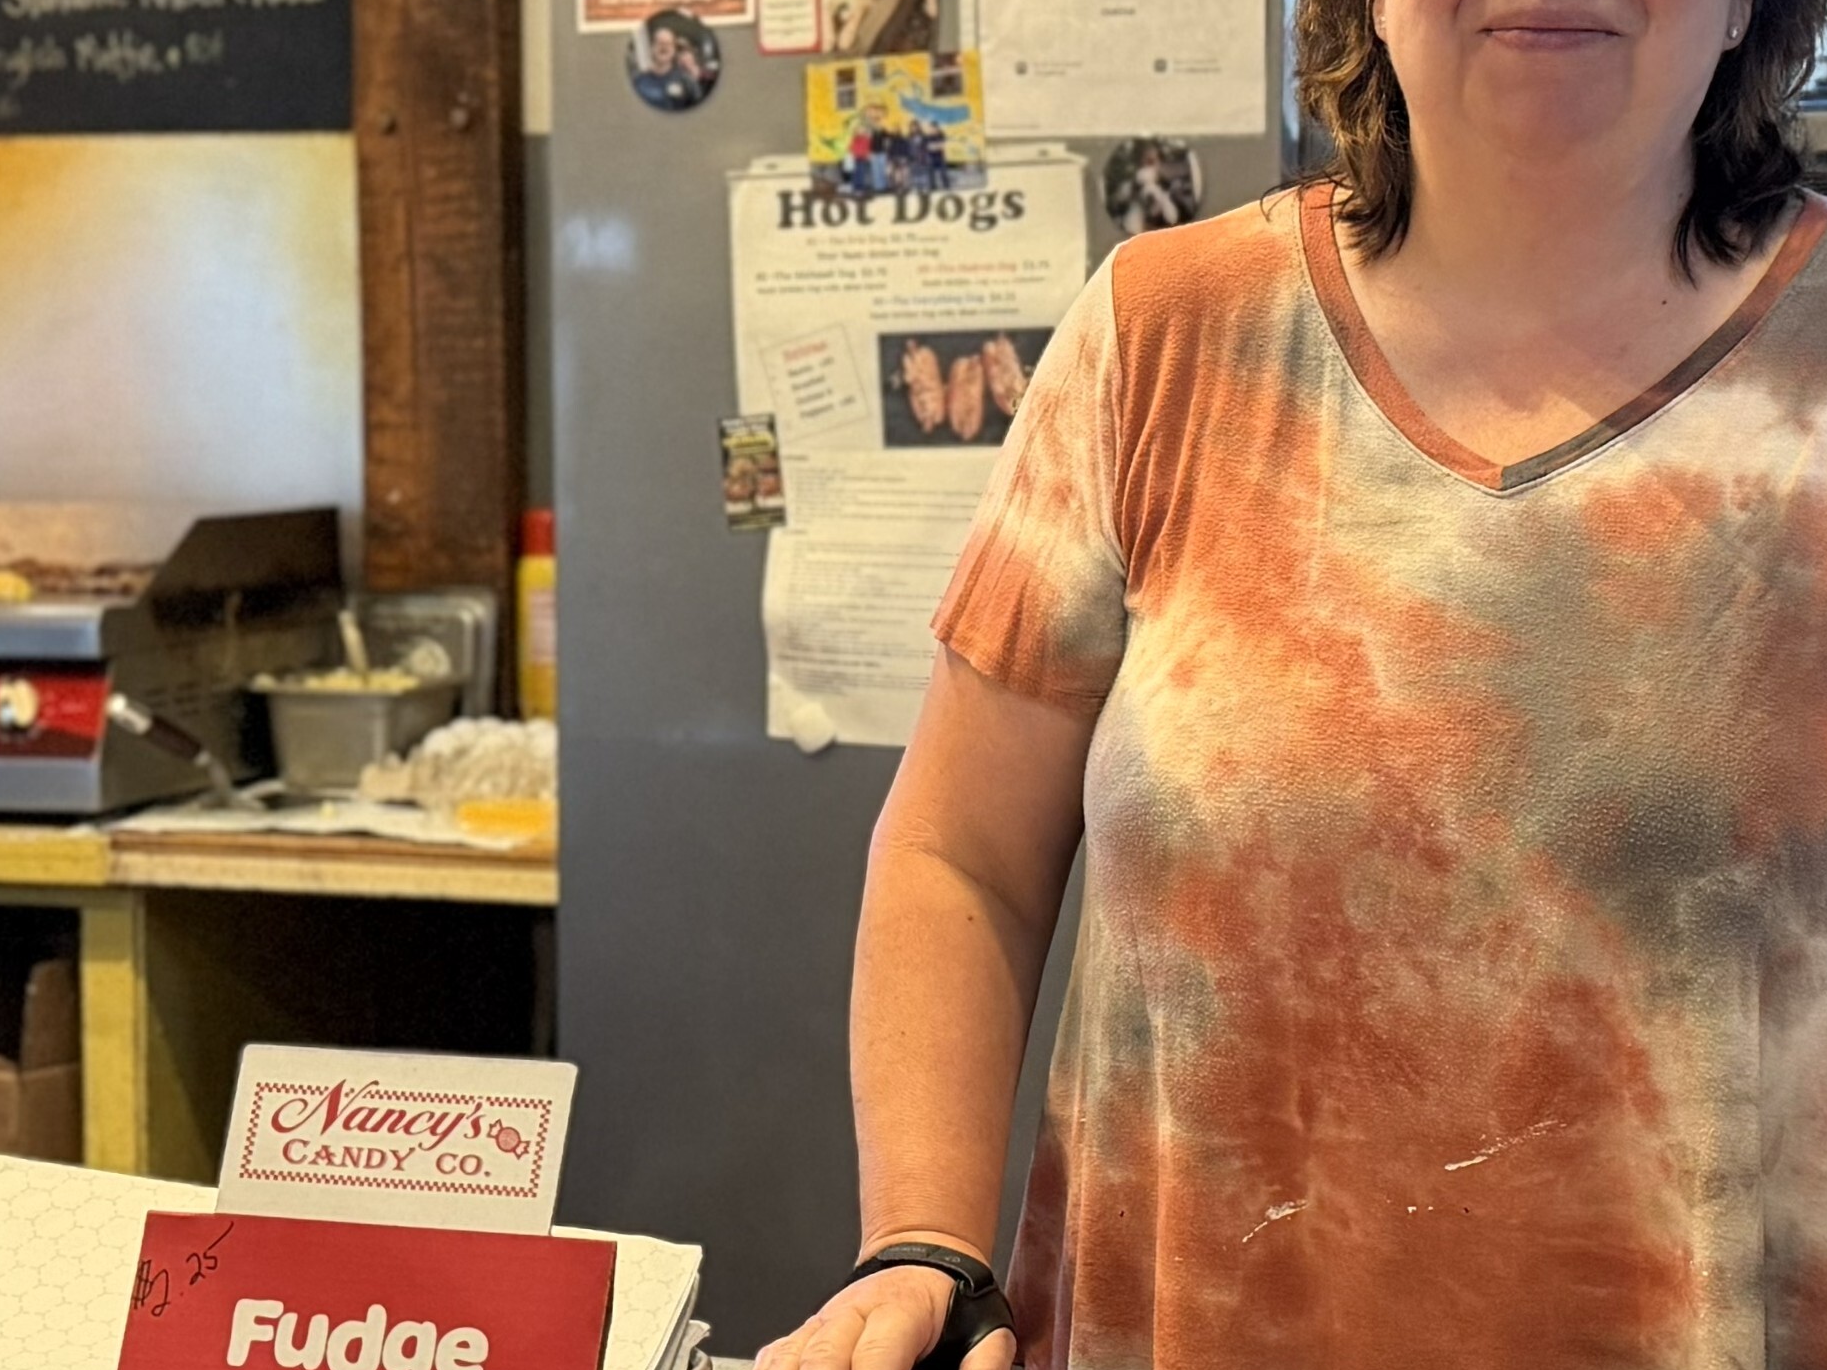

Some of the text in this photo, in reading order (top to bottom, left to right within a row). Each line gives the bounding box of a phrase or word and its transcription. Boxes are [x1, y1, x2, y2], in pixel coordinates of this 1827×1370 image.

[776, 188, 1026, 233] Hot Dogs
[271, 1078, 487, 1151] Nancy's
[282, 1138, 493, 1178] CANDY CO.
